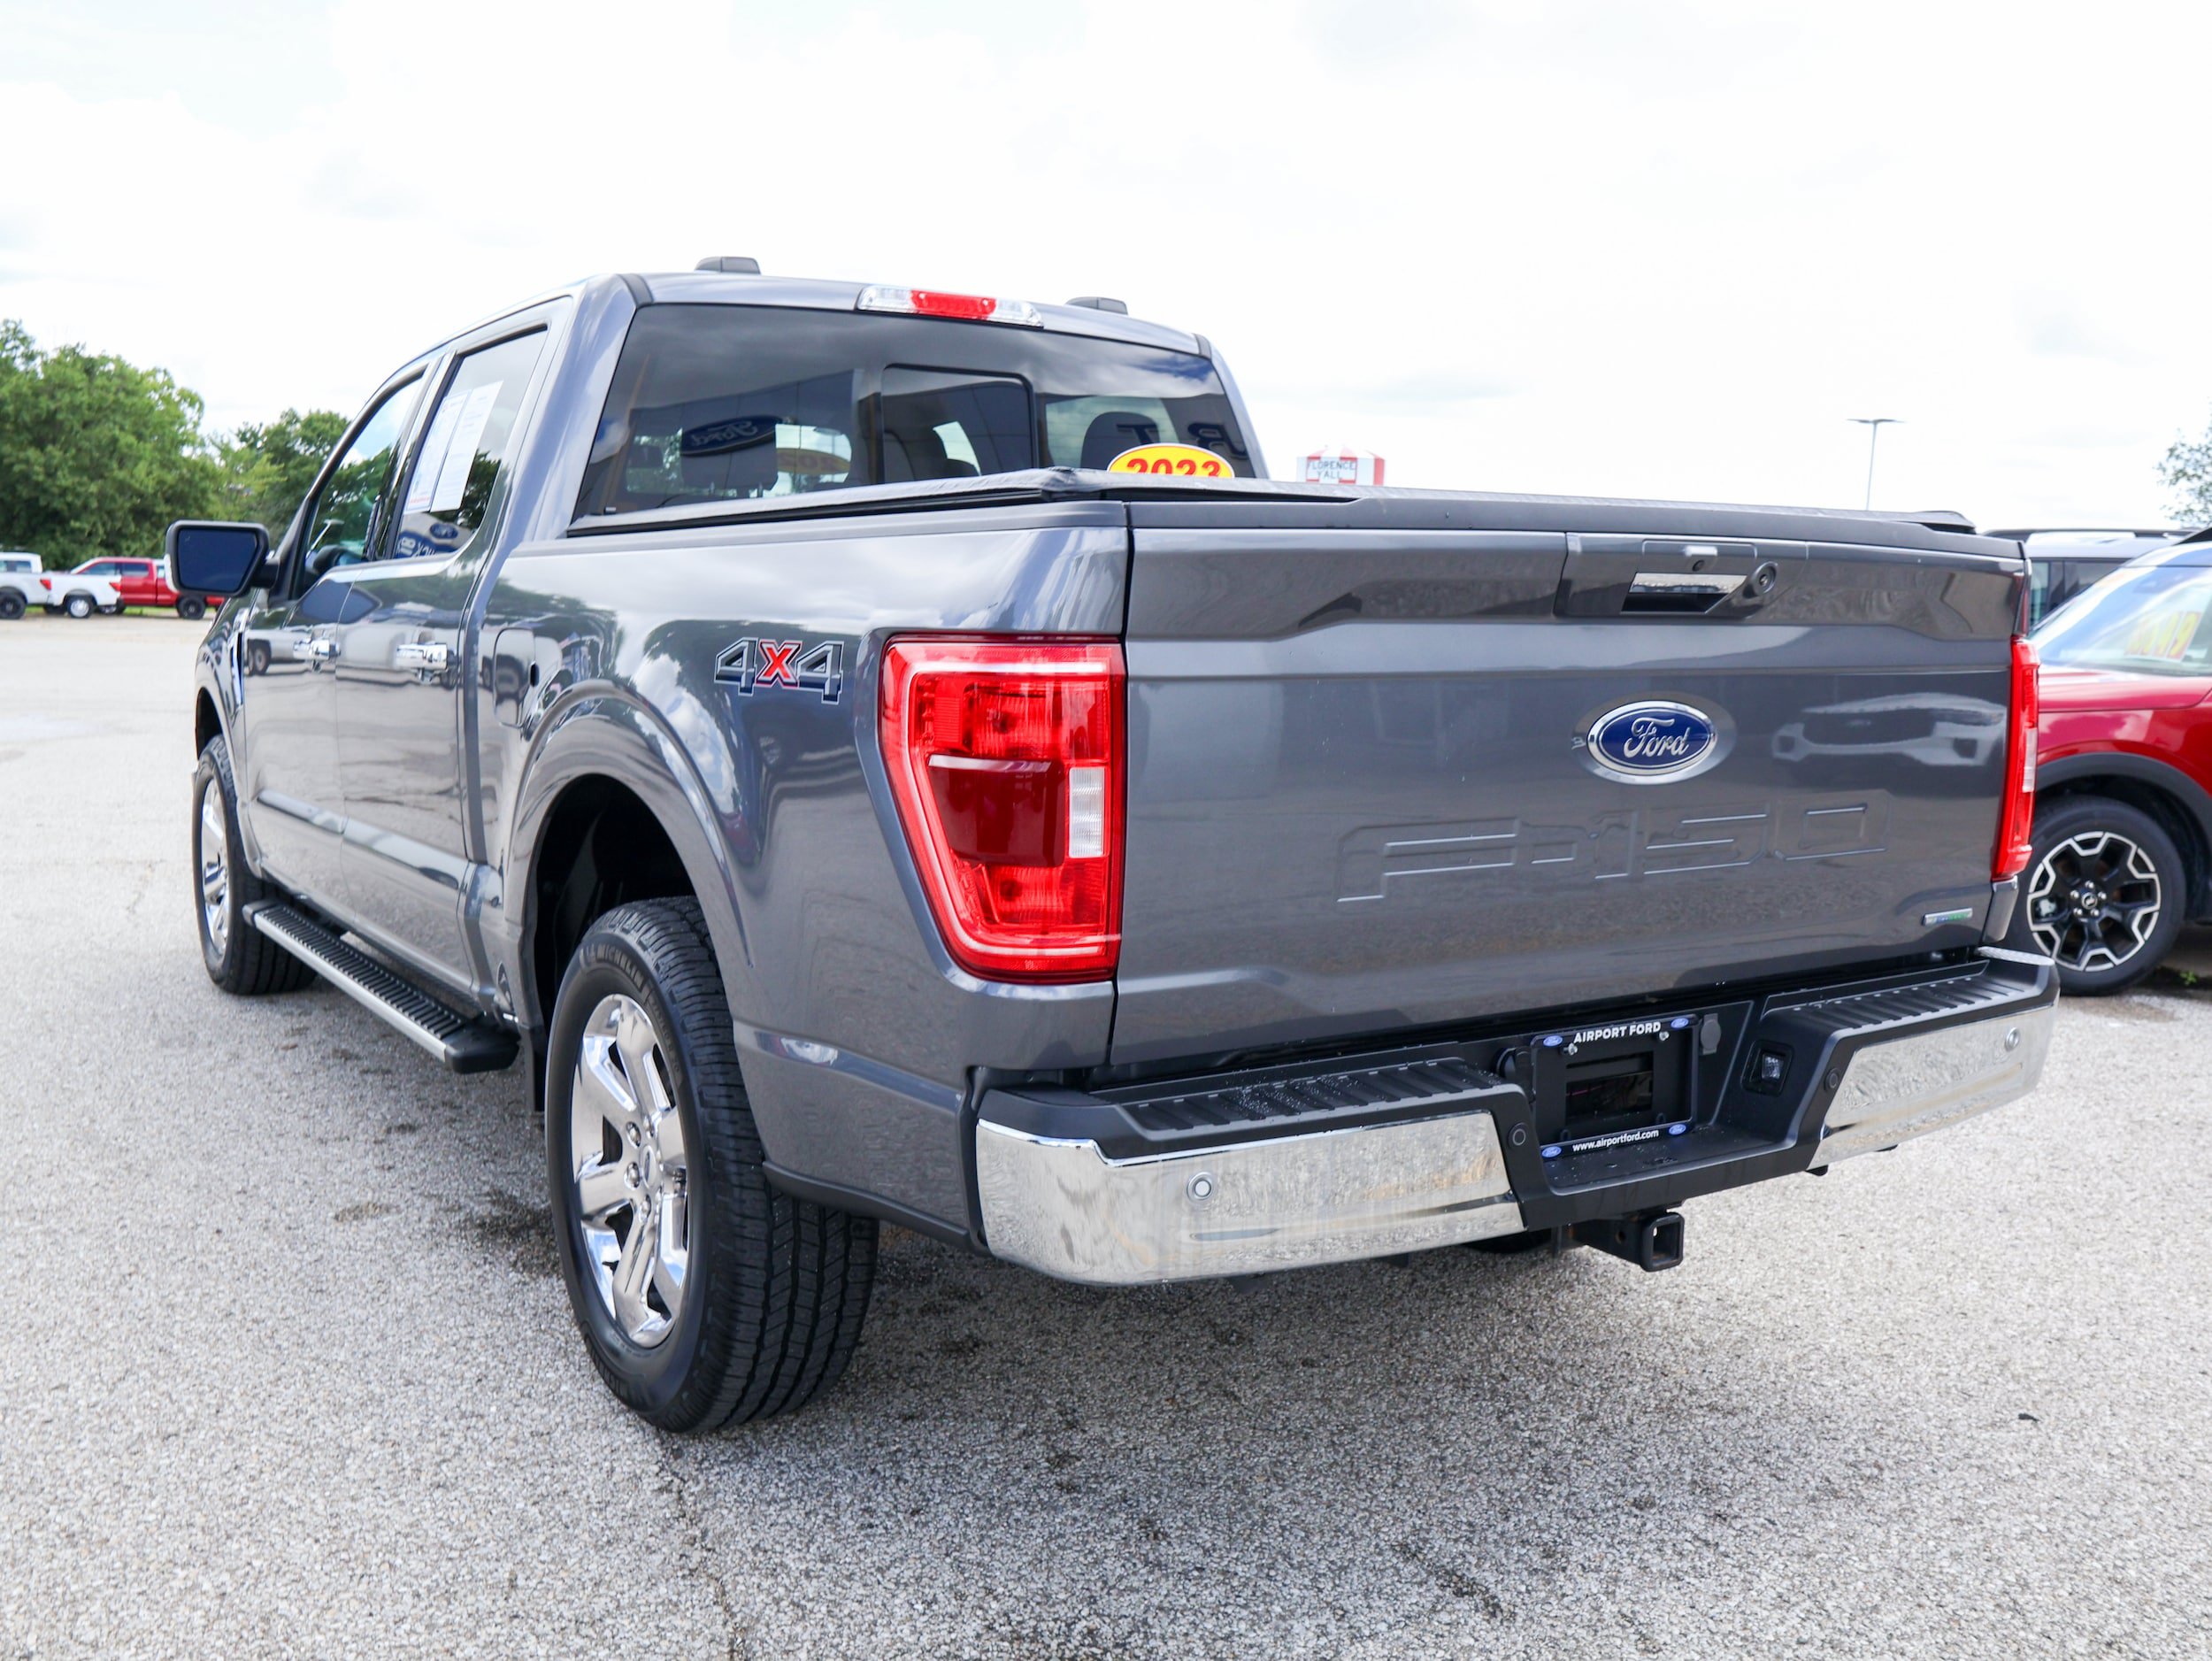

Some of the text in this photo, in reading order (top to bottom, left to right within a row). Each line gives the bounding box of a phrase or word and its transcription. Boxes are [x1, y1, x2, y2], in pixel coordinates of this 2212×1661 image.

[1624, 717, 1691, 757] Ford
[1573, 1021, 1662, 1043] AIRPORT FORD
[1572, 1130, 1659, 1151] www.airportford.com
